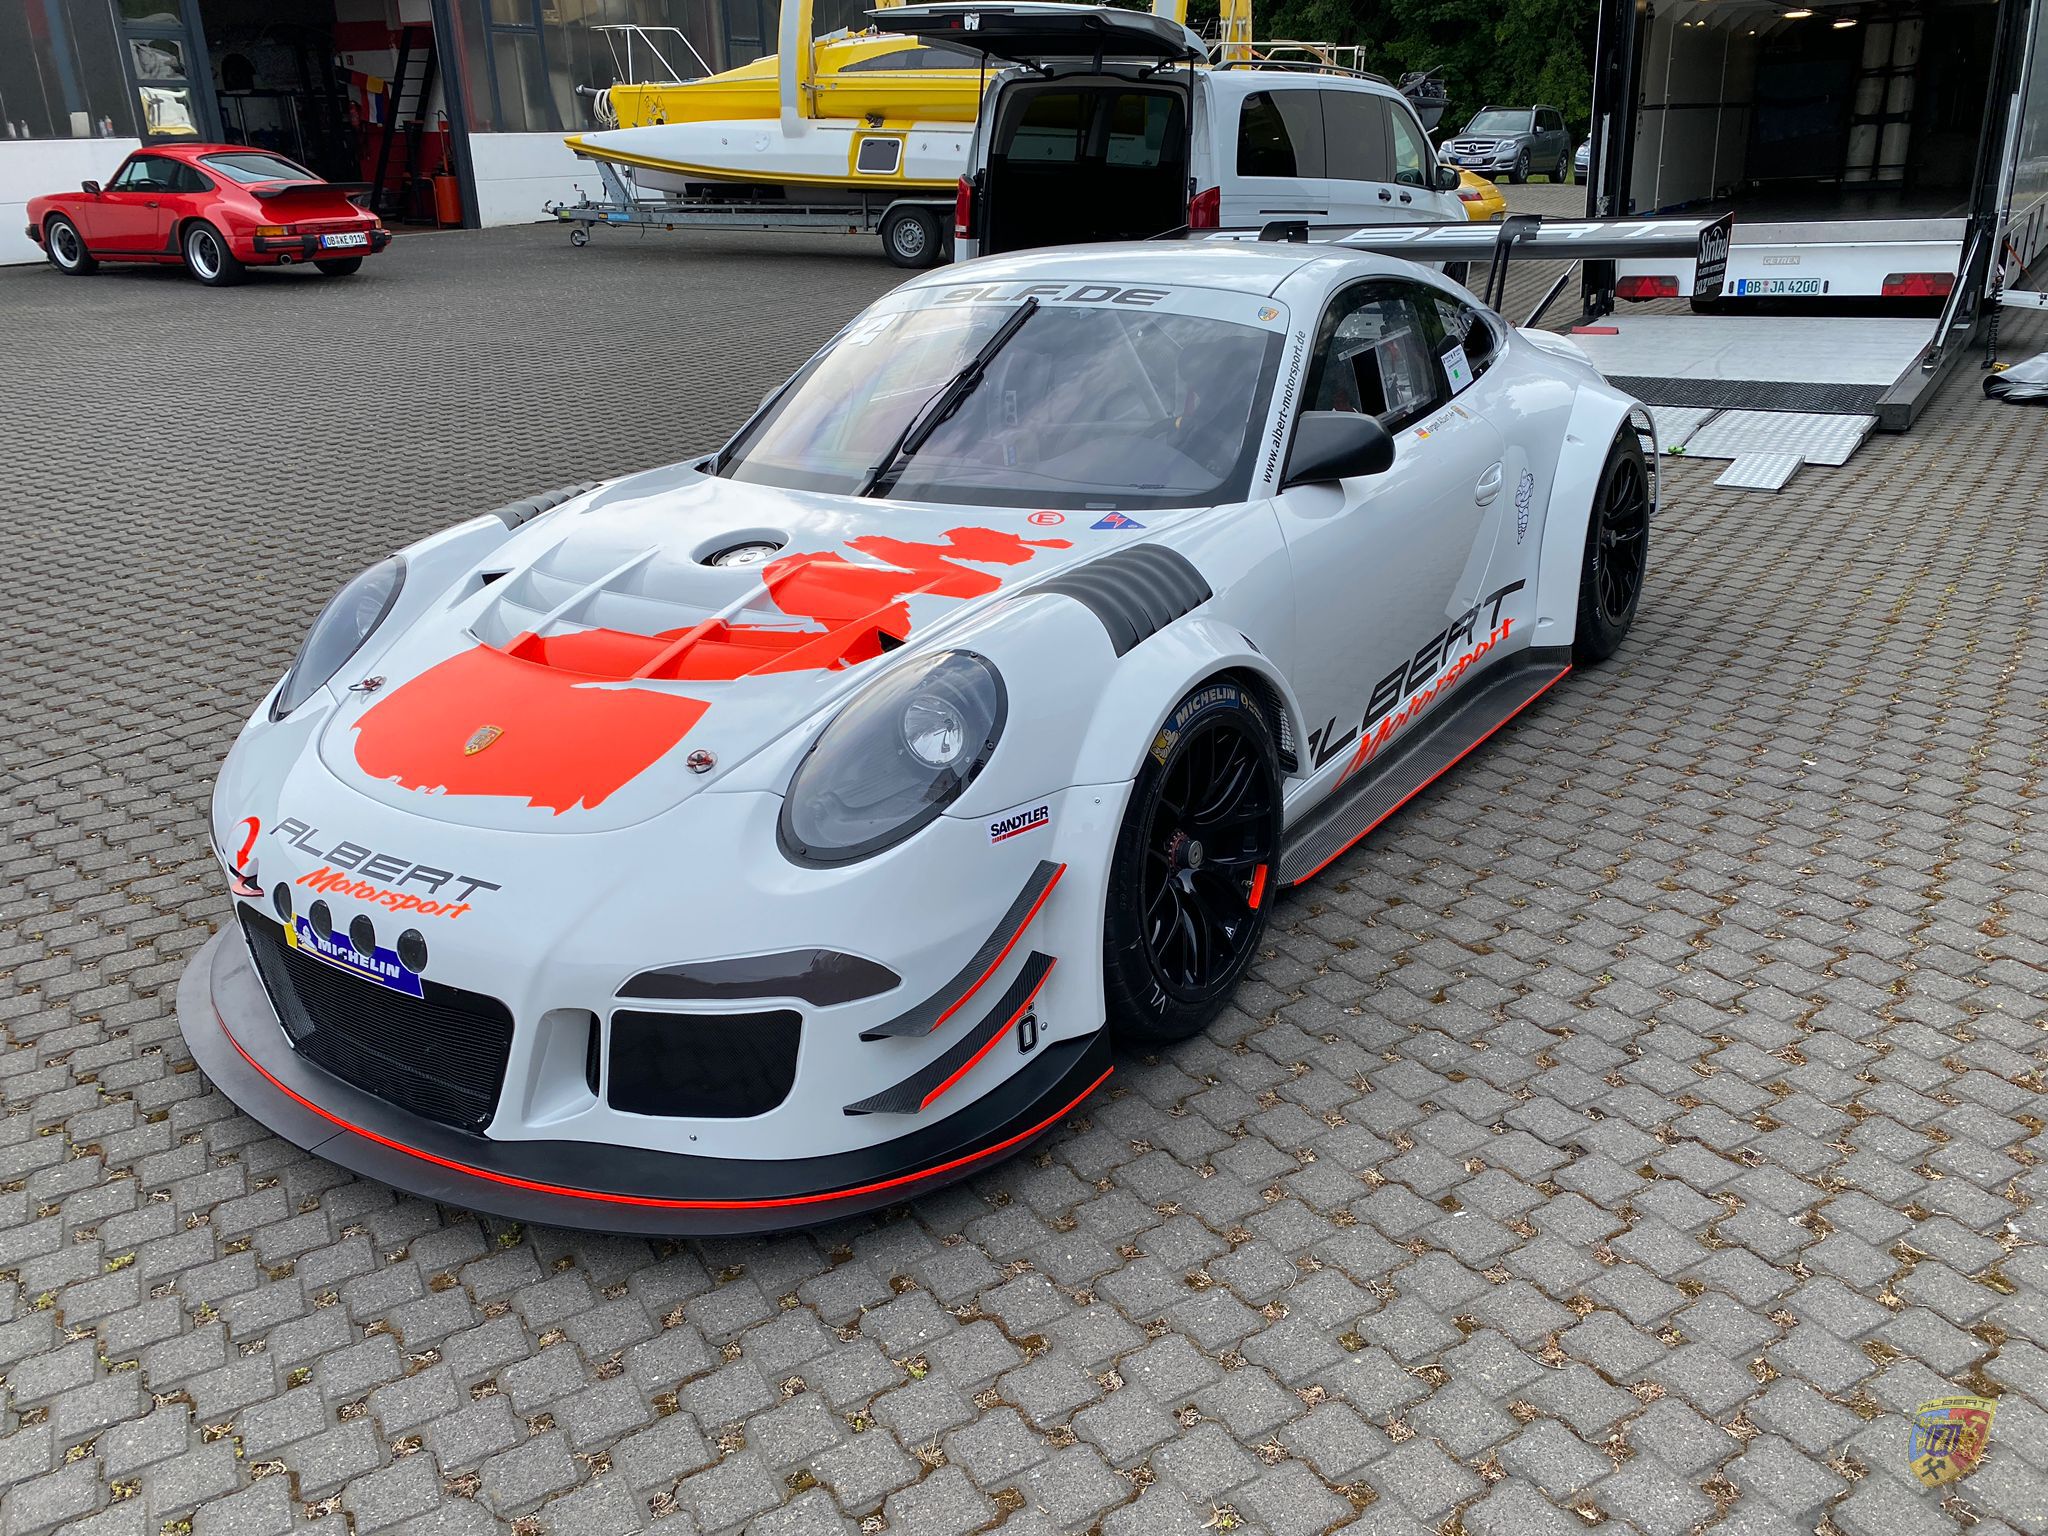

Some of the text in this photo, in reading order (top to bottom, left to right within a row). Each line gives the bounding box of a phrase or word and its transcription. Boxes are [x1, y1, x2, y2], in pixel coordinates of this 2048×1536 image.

[1746, 280, 1818, 293] OB JA 4200
[1263, 330, 1306, 484] www.albert-motorsport.de
[1175, 687, 1236, 728] MICHELIN
[1331, 617, 1516, 792] Motorsport
[991, 805, 1049, 837] SANDTLER
[269, 816, 502, 902] ALBERT
[295, 865, 472, 919] Motorsport
[317, 937, 400, 979] MICHELIN
